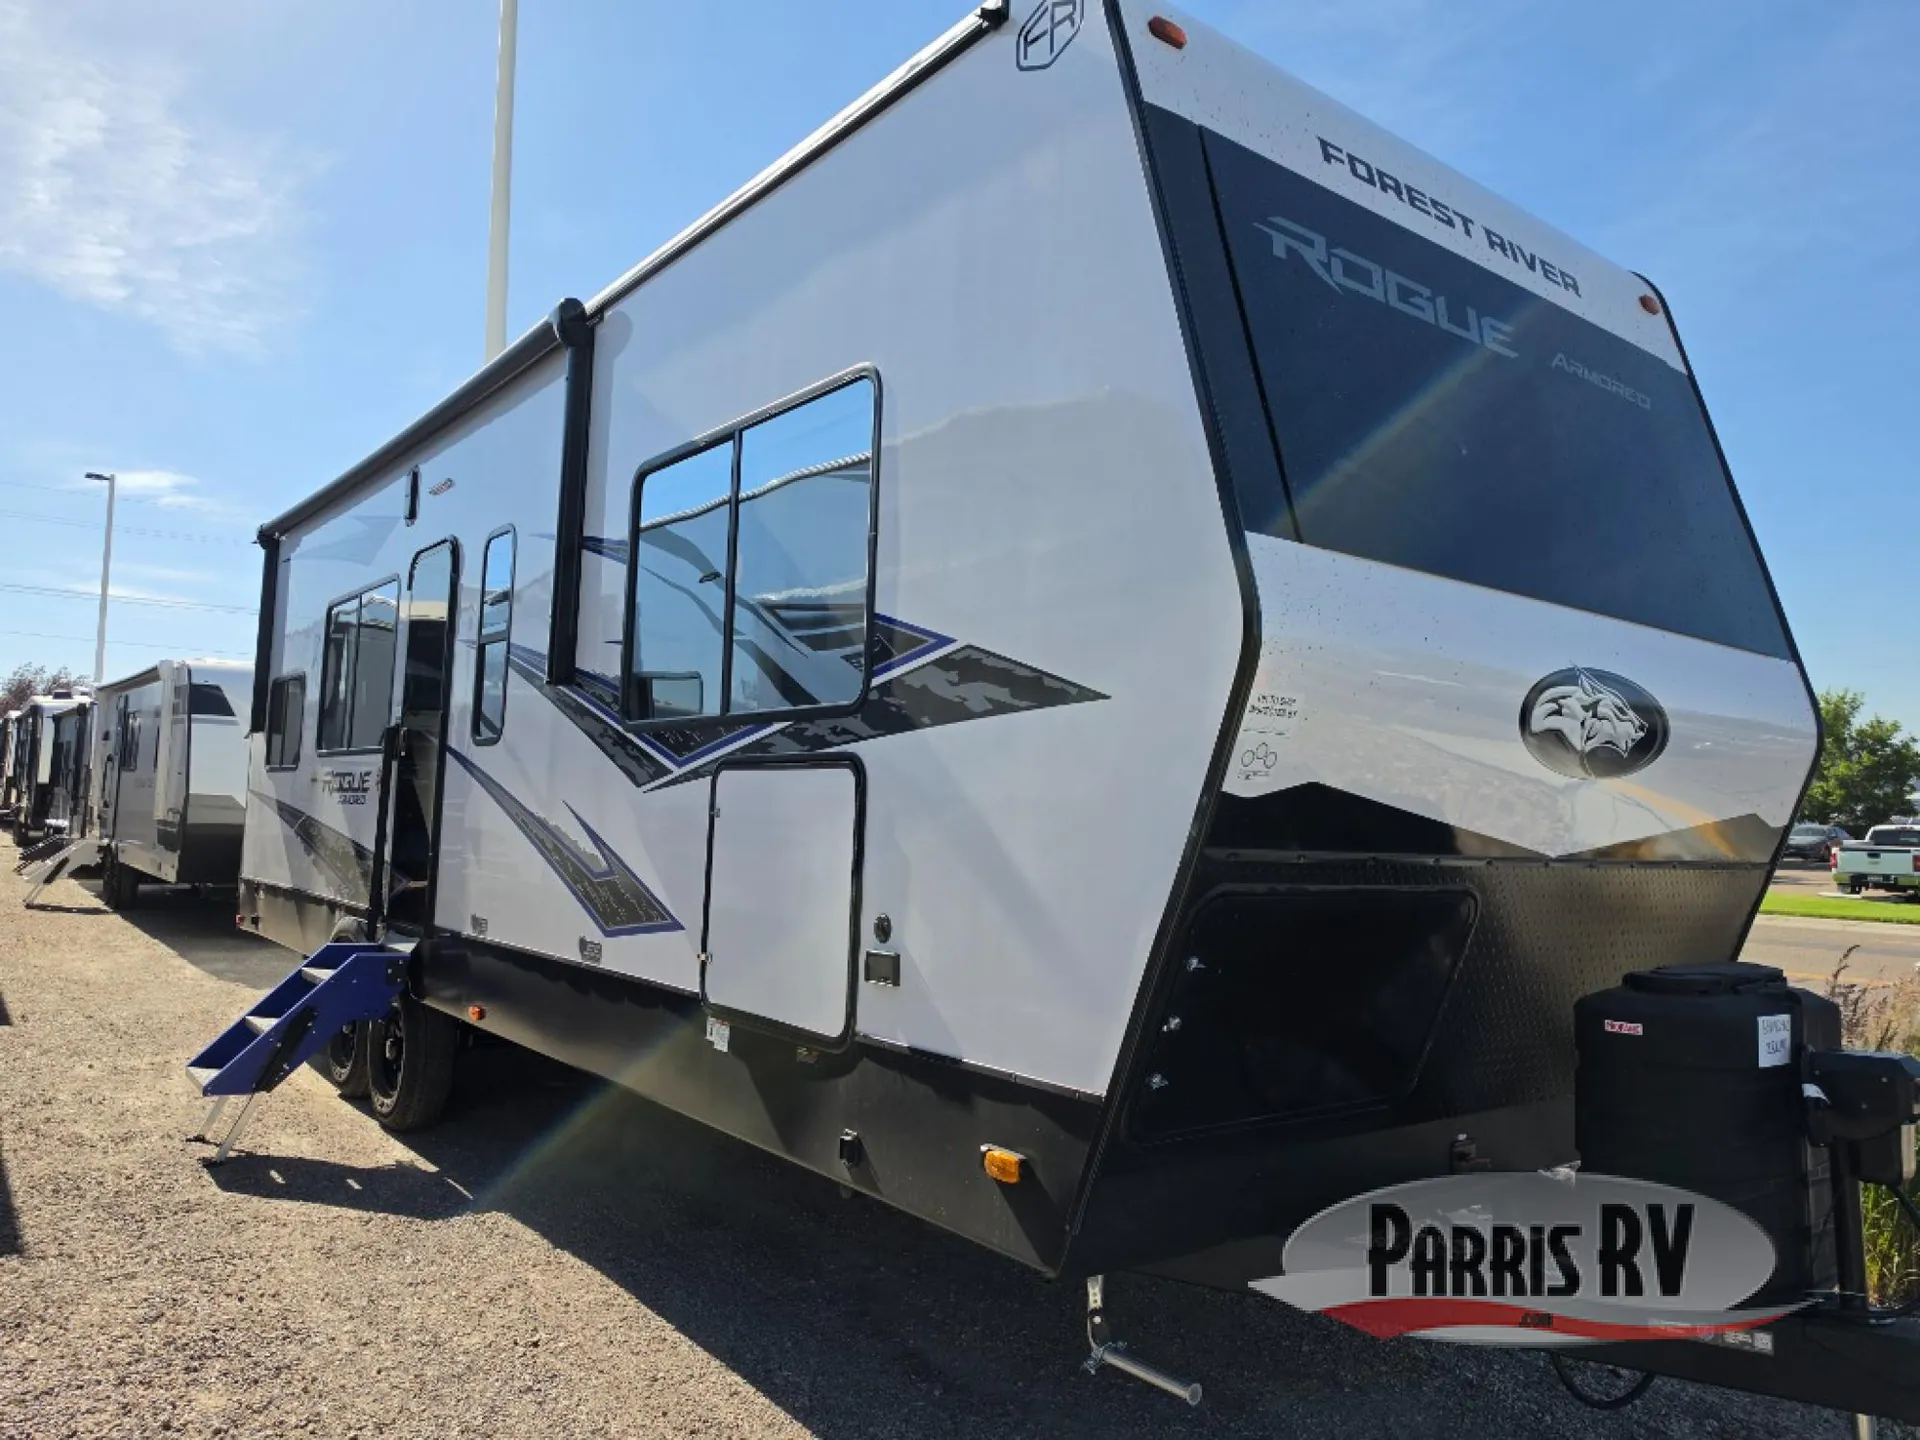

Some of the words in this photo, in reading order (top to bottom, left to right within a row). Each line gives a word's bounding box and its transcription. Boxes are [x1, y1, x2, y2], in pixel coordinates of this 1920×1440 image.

[1252, 215, 1519, 359] ROGUE
[1316, 135, 1475, 239] FOREST
[1481, 225, 1582, 298] RIVER
[1551, 351, 1651, 411] ARMORED
